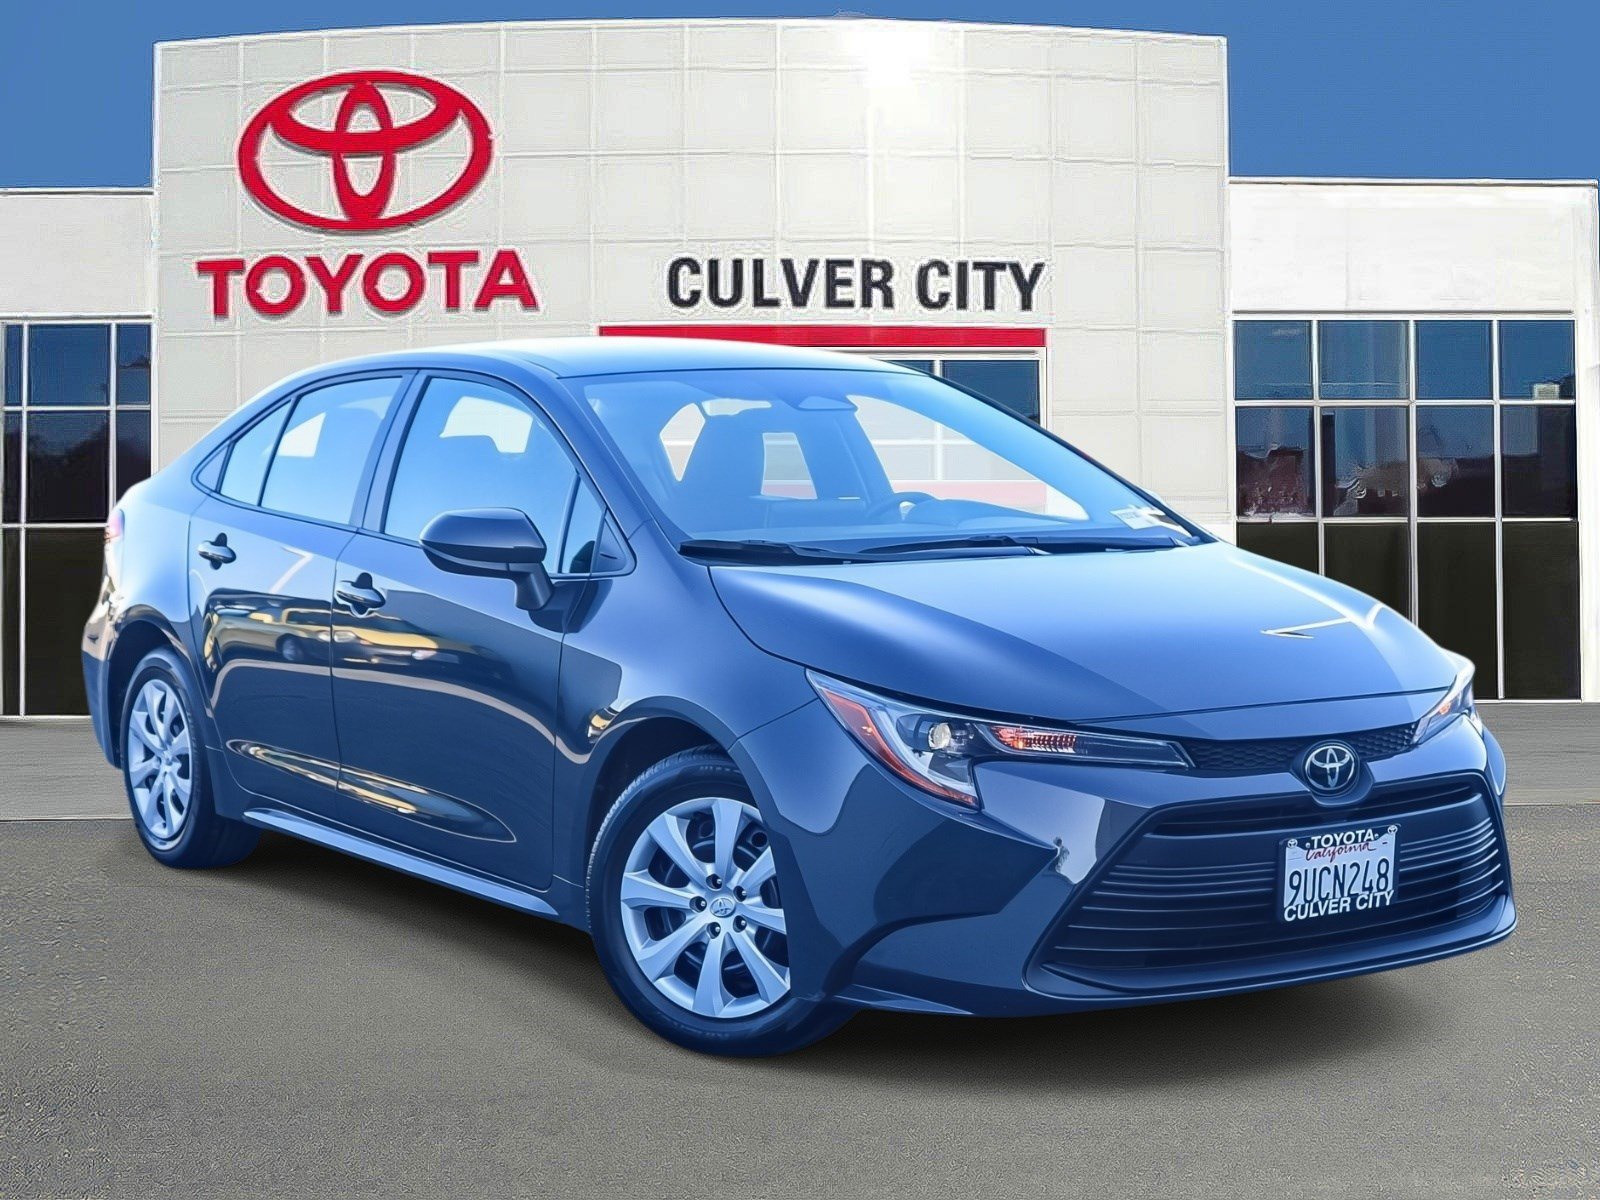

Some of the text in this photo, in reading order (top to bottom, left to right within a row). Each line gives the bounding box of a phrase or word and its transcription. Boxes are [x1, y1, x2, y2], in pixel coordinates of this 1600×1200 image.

[196, 249, 540, 319] TOYOTA
[667, 257, 1046, 312] CULVER CITY
[1305, 842, 1376, 862] California
[1311, 828, 1375, 850] TOYOTA
[1286, 858, 1390, 908] 9UCN248
[1284, 889, 1394, 922] CULVER CITY
